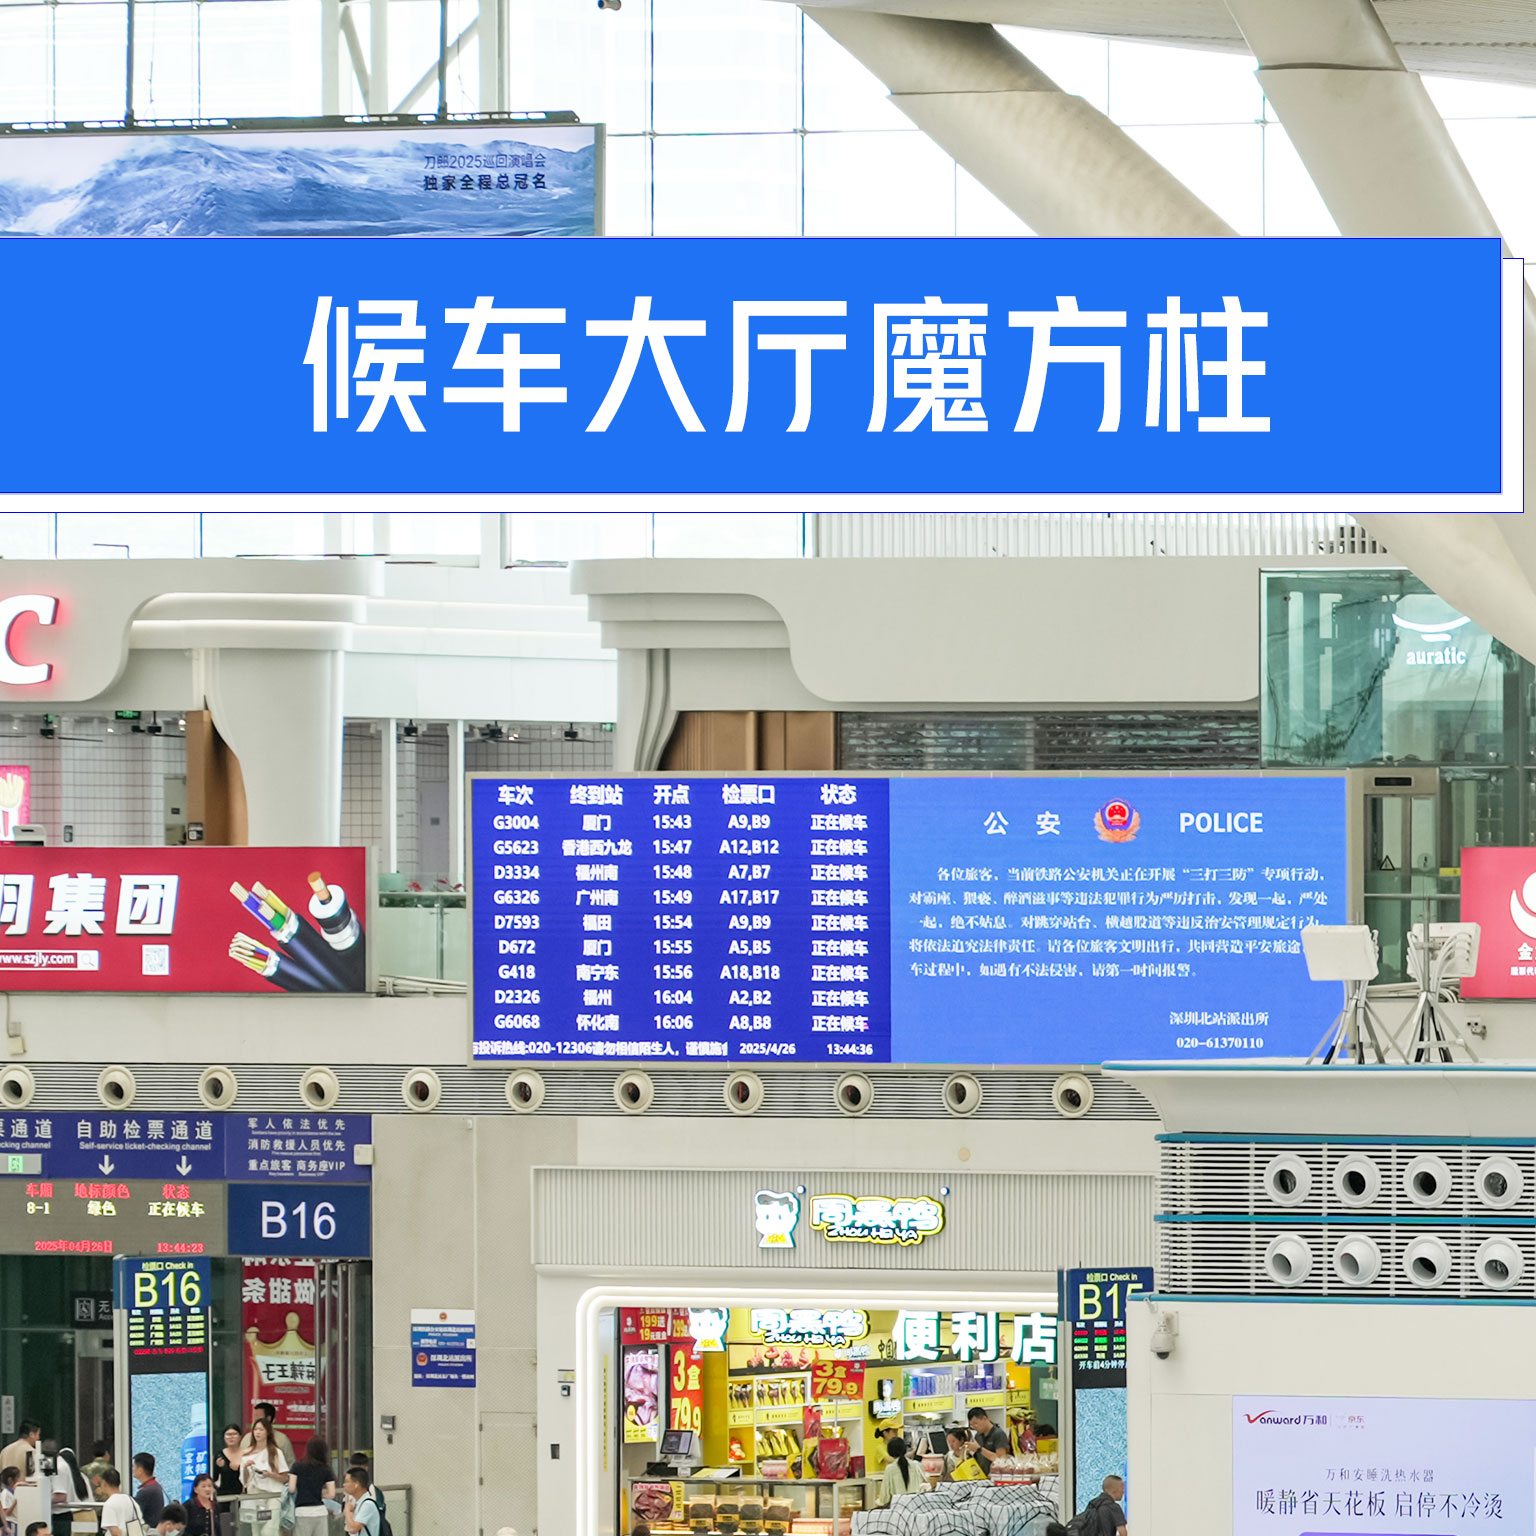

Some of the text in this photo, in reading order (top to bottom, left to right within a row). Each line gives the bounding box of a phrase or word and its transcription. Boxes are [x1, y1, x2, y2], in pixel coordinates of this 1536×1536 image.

[424, 173, 546, 191] 独家全程总冠名
[1406, 646, 1467, 665] auratic
[497, 783, 857, 806] 车次 终到站 开点 检票口 状态
[493, 813, 868, 831] G3004 15:43 正在候车
[984, 810, 1263, 836] 公安 POLICE
[493, 838, 869, 856] G5623 15:47 正在候车
[493, 864, 693, 880] D3334 15:48
[493, 889, 693, 905] G6326 15:49
[494, 914, 693, 930] D7593 15:54
[498, 939, 693, 955] D672 15:55
[498, 964, 694, 980] G418 15:56
[494, 989, 694, 1005] D2326 16:04
[493, 1014, 694, 1030] G6068 16:06
[1169, 1011, 1270, 1027] 深圳北站派出所
[826, 1043, 874, 1055] 13:44:36
[1176, 1036, 1264, 1049] 020-61370110
[77, 1119, 213, 1140] 自助检票通道
[248, 1118, 345, 1130] 军人依法优先
[182, 1142, 212, 1151] channel
[248, 1139, 345, 1151] 消防救援人员优先
[248, 1159, 292, 1171] 重点旅客
[26, 1183, 191, 1200] 车厢 地标颜色 状态
[87, 1201, 205, 1218] 绿色 正在候车
[811, 1194, 945, 1230] 周黑鸭
[261, 1200, 336, 1240] B16
[35, 1240, 204, 1254] 2025年04月26日 13:44:23
[134, 1270, 201, 1308] B16
[750, 1309, 867, 1338] 周黑鸭
[893, 1308, 1057, 1363] 便利店
[673, 1351, 702, 1391] 3盒
[815, 1362, 848, 1378] 3盒
[813, 1378, 859, 1396] 79.9
[1243, 1409, 1328, 1426] Vanward 万和
[1325, 1467, 1436, 1484] 万和安睡洗热水器
[1255, 1487, 1504, 1520] 暖静省天花板 启停不冷烫
